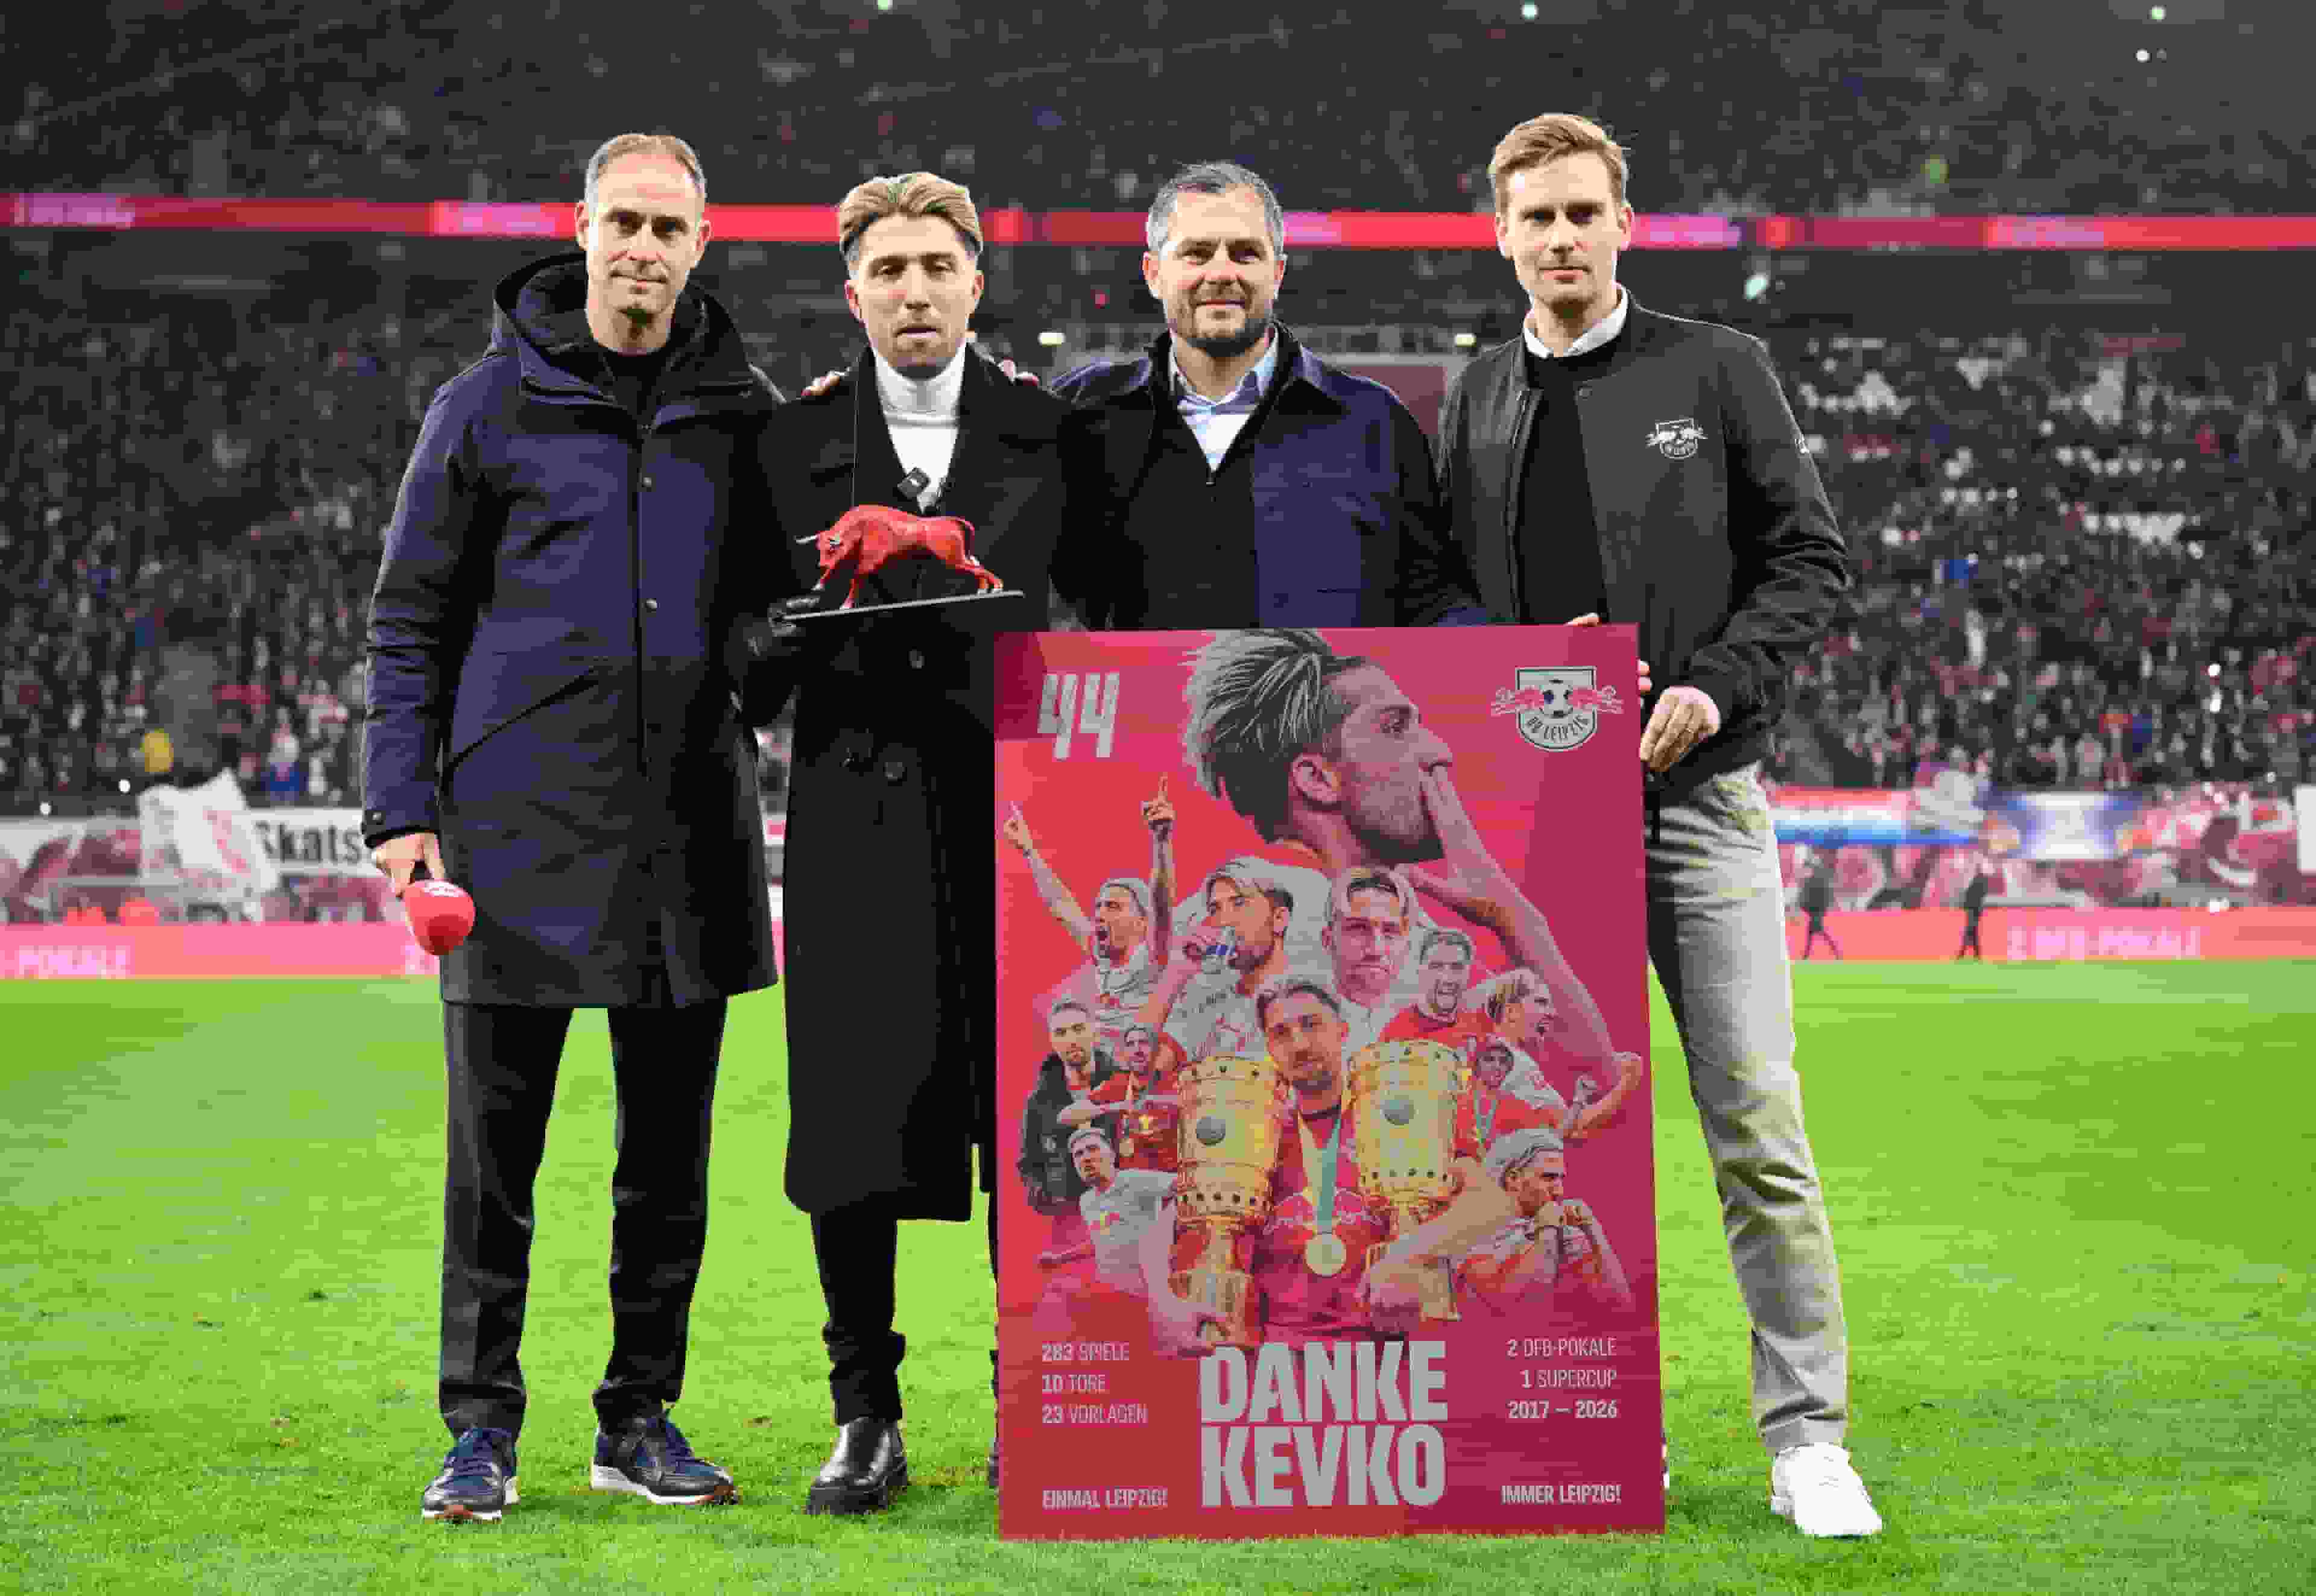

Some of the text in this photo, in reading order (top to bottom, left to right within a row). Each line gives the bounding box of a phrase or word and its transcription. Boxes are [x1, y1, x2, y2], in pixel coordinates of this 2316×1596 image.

[1039, 673, 1119, 760] 44
[1042, 1342, 1129, 1360] 283 SPIELE
[1506, 1337, 1616, 1356] 2 DFB-POKALE
[1042, 1375, 1106, 1393] 10 TORE
[1200, 1341, 1448, 1422] DANKE
[1520, 1370, 1617, 1389] 1 SUPERCUP
[1042, 1404, 1148, 1423] 23 VORLAGEN
[1507, 1399, 1549, 1418] 2017
[1575, 1399, 1617, 1418] 2026
[1201, 1424, 1446, 1507] KEVKO
[1043, 1488, 1168, 1510] EINMAL LEIPZIG!
[1501, 1484, 1622, 1506] IMMER LEIPZIG!
